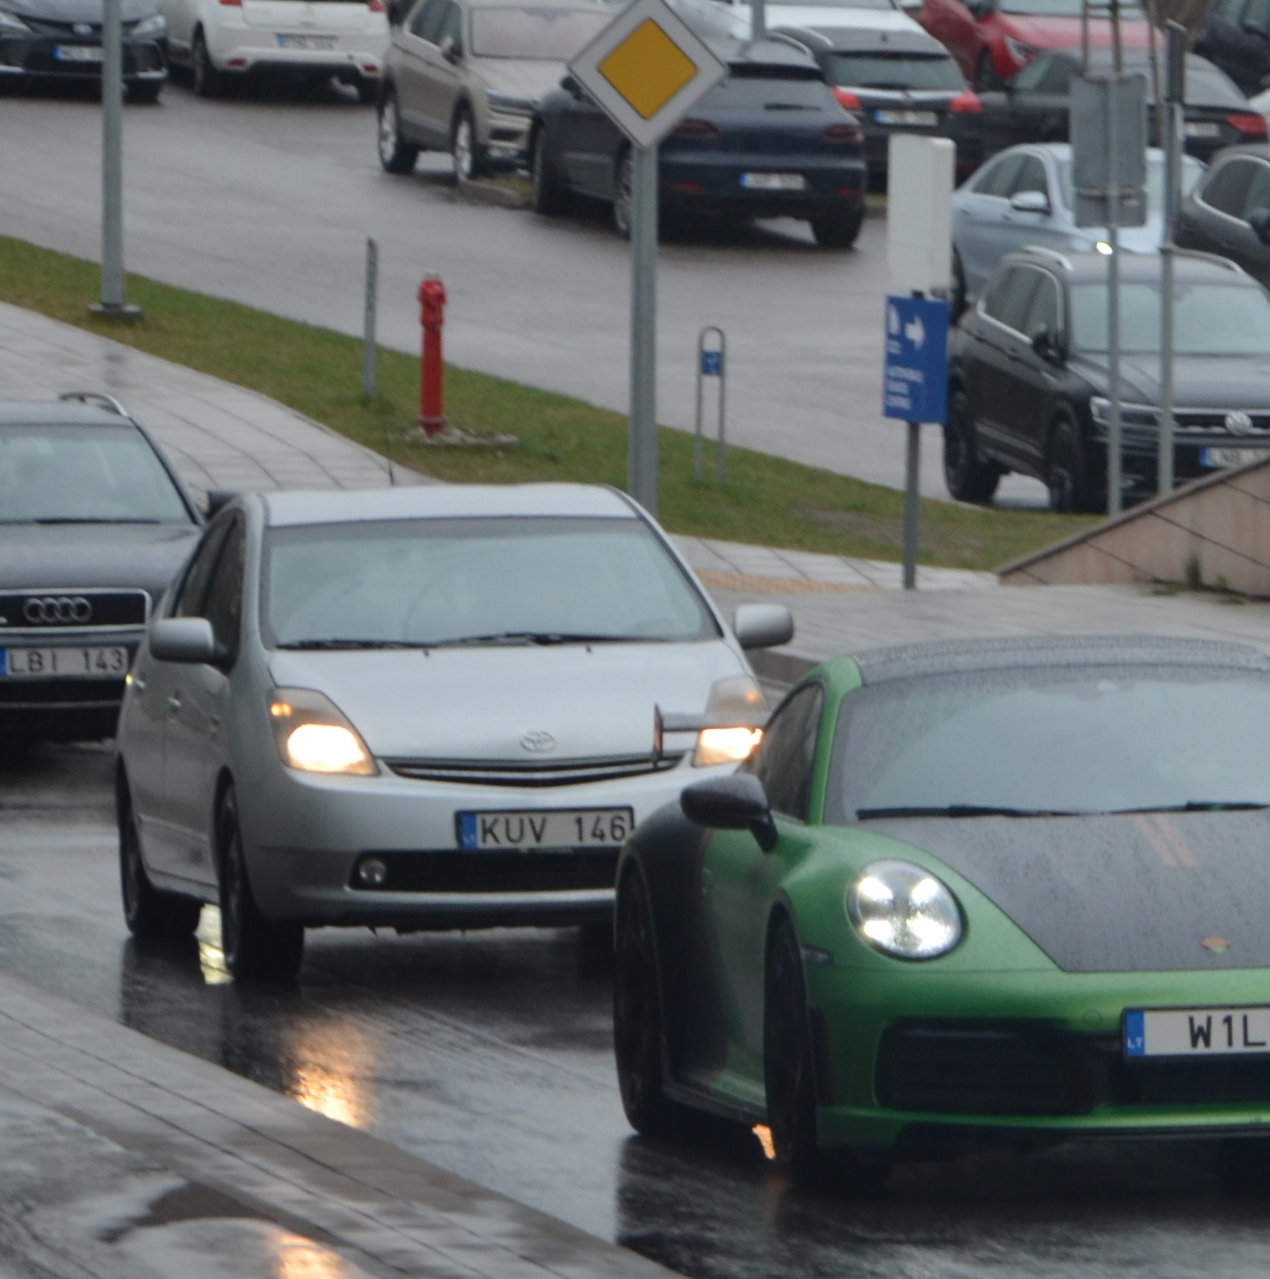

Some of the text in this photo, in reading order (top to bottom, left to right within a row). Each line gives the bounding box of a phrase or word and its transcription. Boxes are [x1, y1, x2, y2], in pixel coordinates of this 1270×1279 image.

[9, 647, 123, 673] LBI 143
[481, 814, 627, 844] KUV 146
[1126, 1036, 1143, 1049] LT
